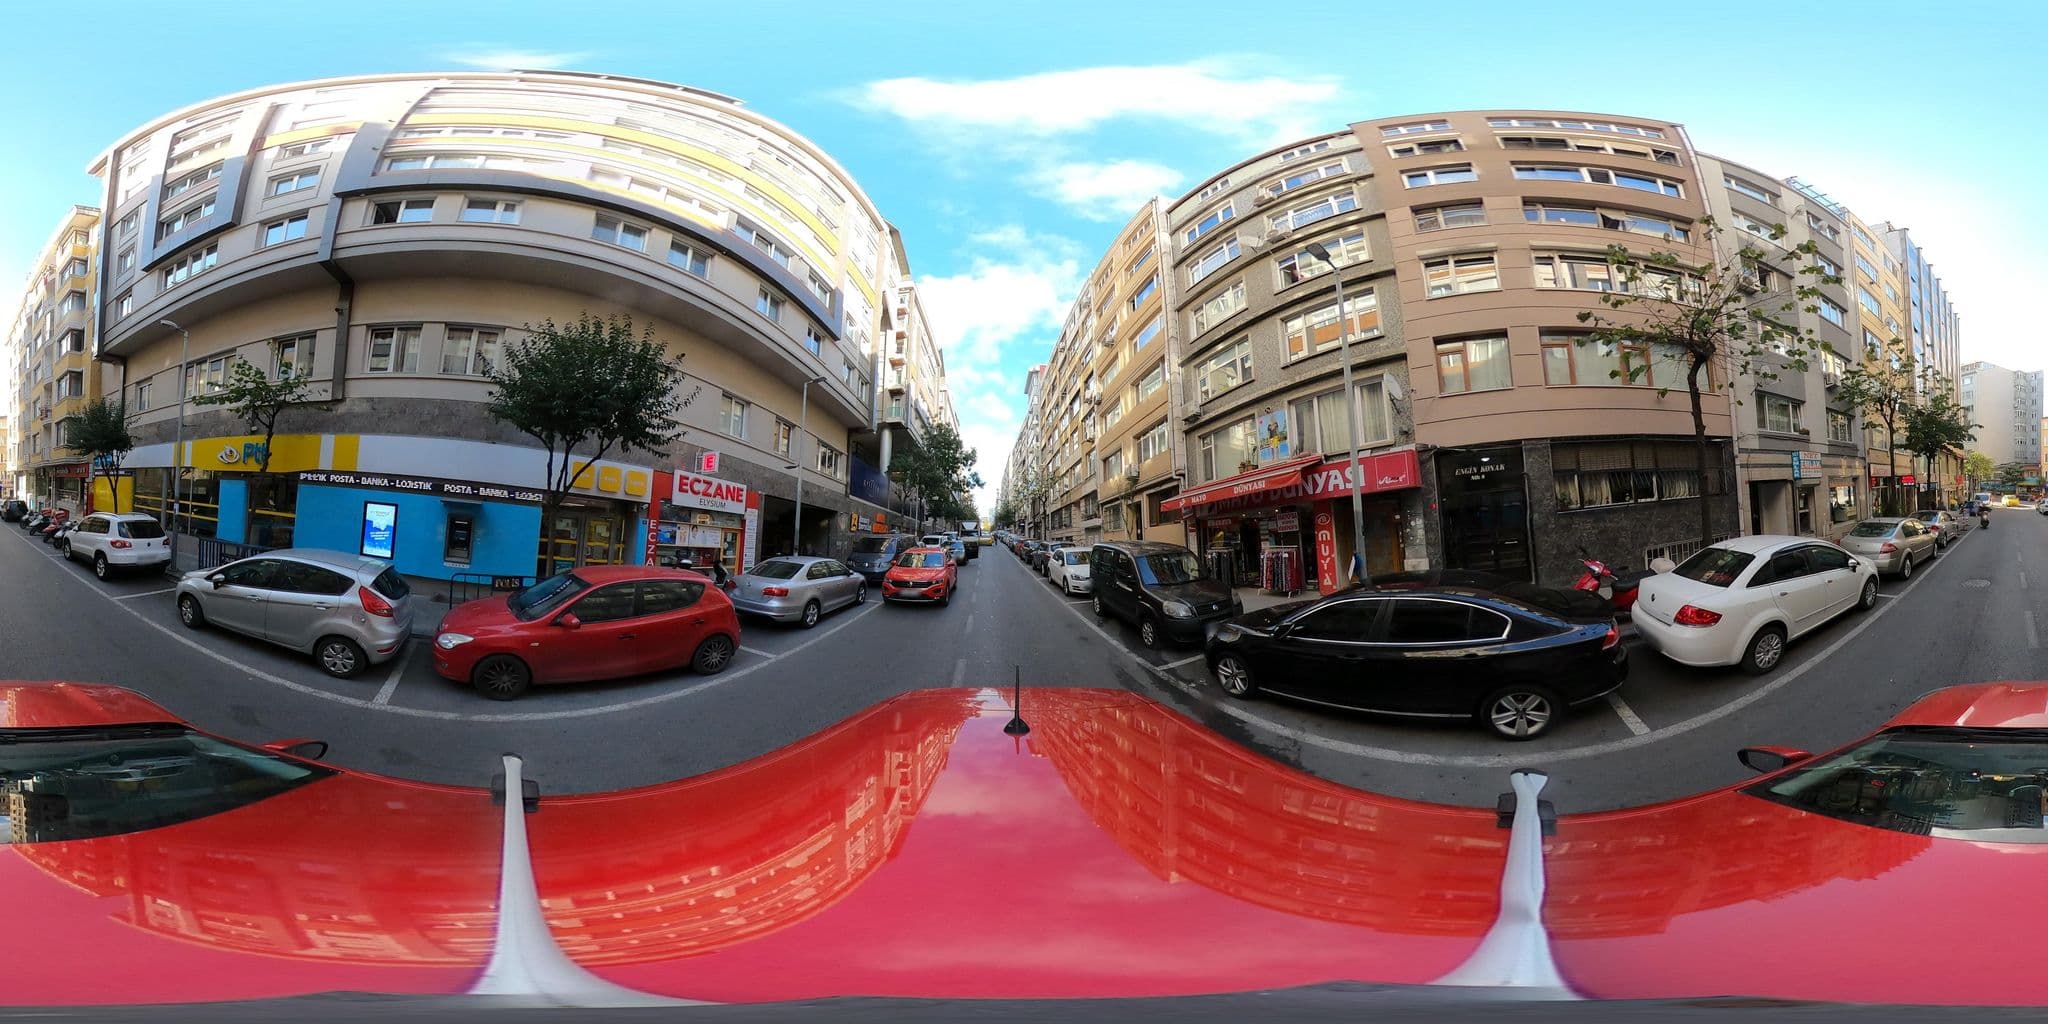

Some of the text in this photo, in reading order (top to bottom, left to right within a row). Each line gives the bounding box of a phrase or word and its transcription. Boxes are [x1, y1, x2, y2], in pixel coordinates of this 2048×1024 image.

[704, 453, 716, 471] E
[329, 474, 355, 485] POSTA
[443, 483, 473, 495] POSTA
[678, 474, 744, 503] ECZANE
[1191, 494, 1207, 504] MAYO
[1233, 480, 1266, 494] DÜNYASI
[699, 497, 727, 510] ELYSIUM
